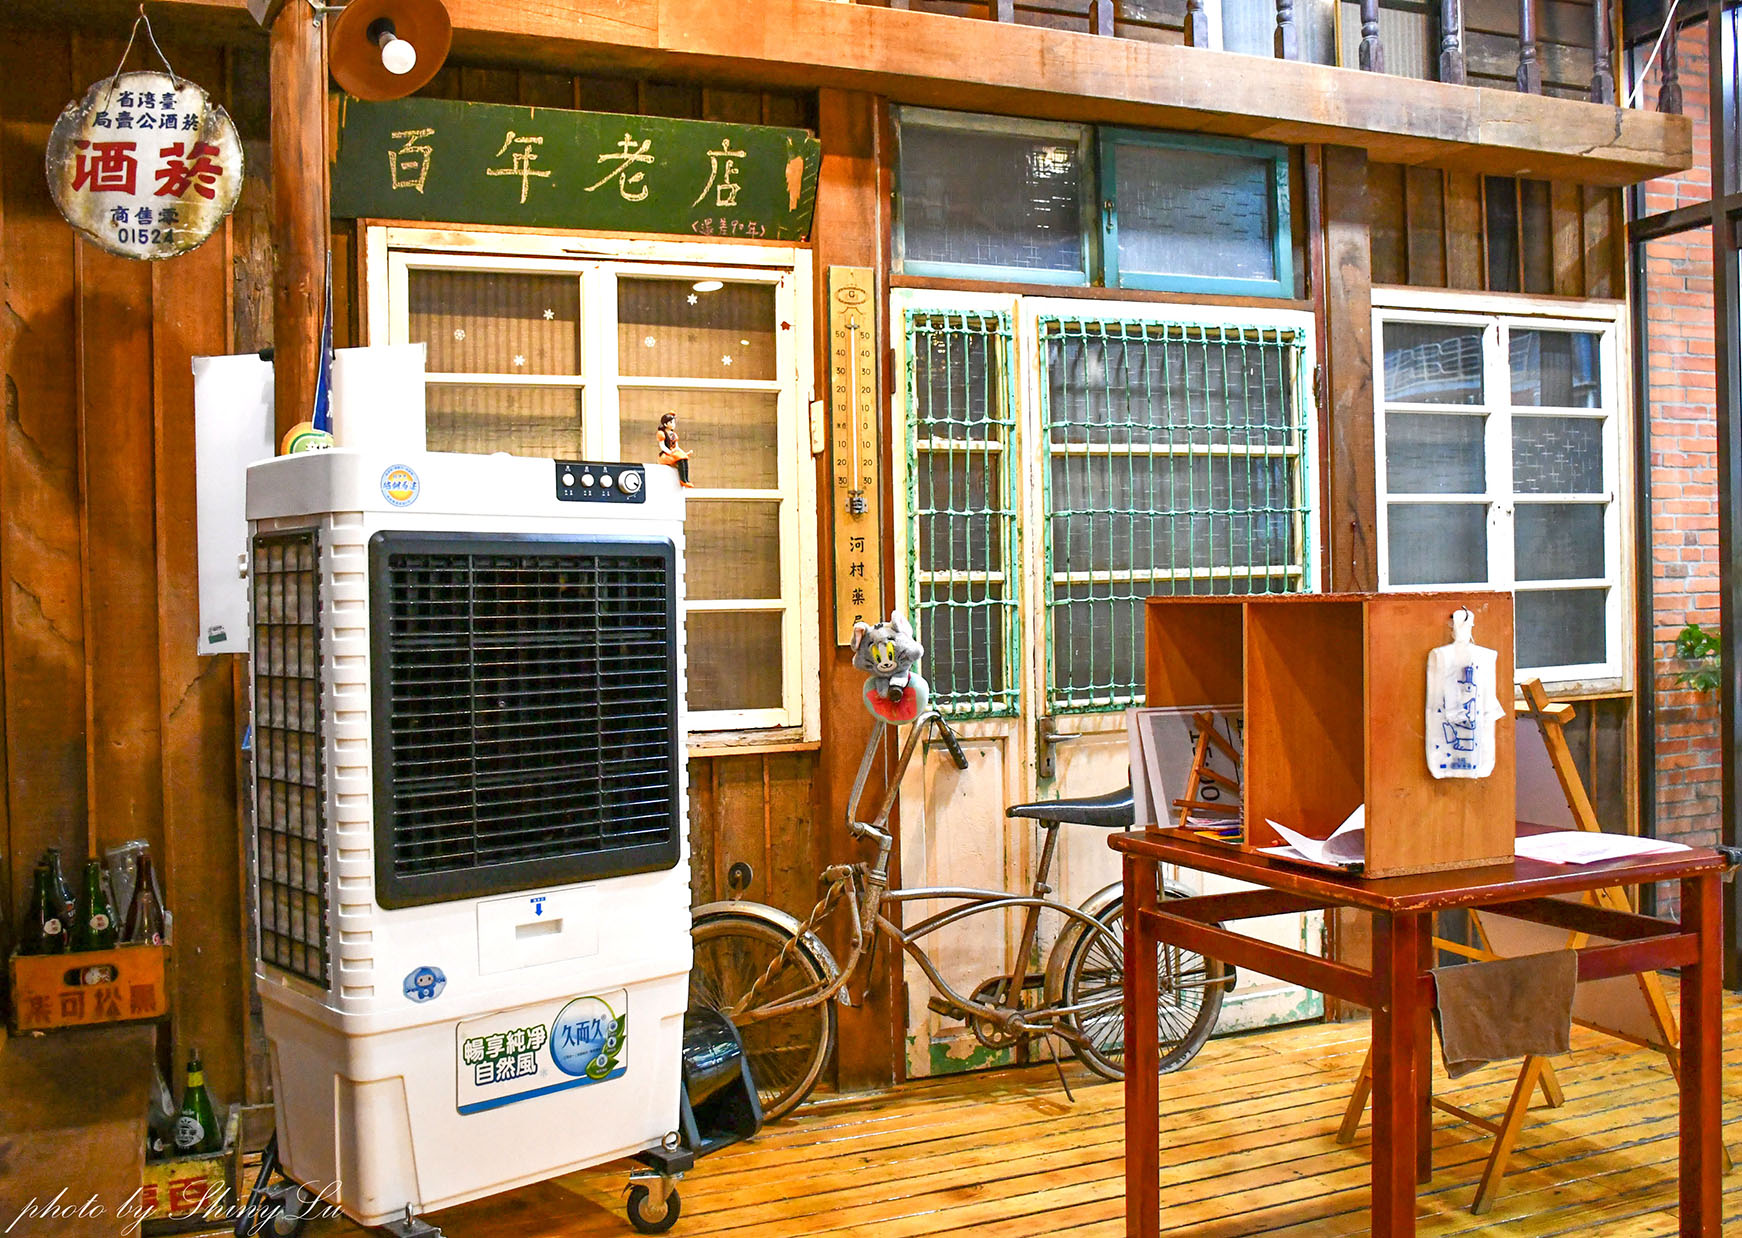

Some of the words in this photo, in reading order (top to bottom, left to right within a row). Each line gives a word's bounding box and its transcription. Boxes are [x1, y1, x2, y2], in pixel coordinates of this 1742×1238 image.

[387, 127, 747, 208] 百年老店
[118, 228, 175, 244] 01524
[834, 330, 846, 339] 50
[860, 331, 871, 340] 50
[835, 348, 846, 357] 40
[860, 350, 871, 358] 40
[836, 385, 847, 393] 20
[861, 386, 871, 394] 20
[837, 404, 847, 412] 10
[861, 404, 870, 412] 10
[862, 422, 869, 430] 0
[837, 440, 847, 448] 10
[862, 441, 871, 449] 10
[837, 458, 847, 466] 20
[863, 459, 873, 467] 20
[561, 1017, 604, 1049] 久而久
[475, 1051, 537, 1086] 自然風
